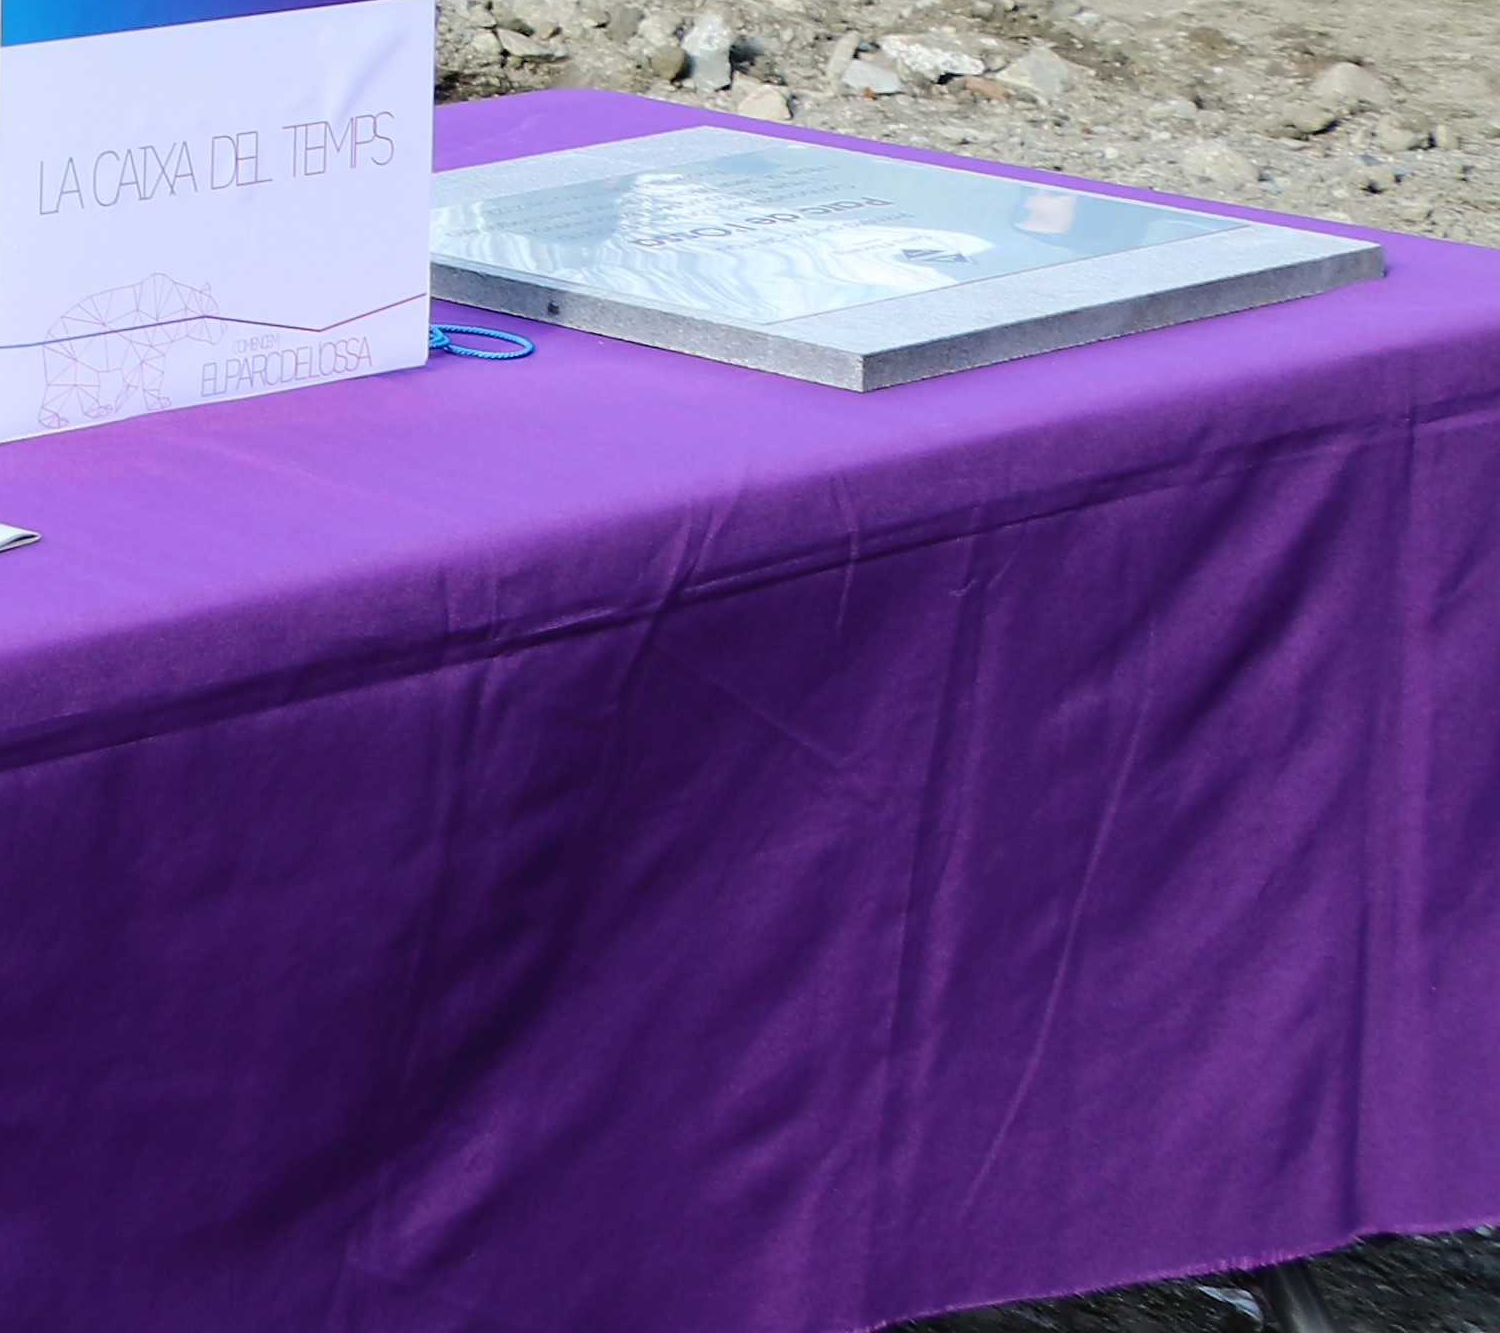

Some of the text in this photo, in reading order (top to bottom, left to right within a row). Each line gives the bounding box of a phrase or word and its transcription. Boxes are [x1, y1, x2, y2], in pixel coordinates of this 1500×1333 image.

[39, 112, 395, 215] LA CAIXA DEL TEMPS
[624, 197, 898, 249] Parc de l'Ossa
